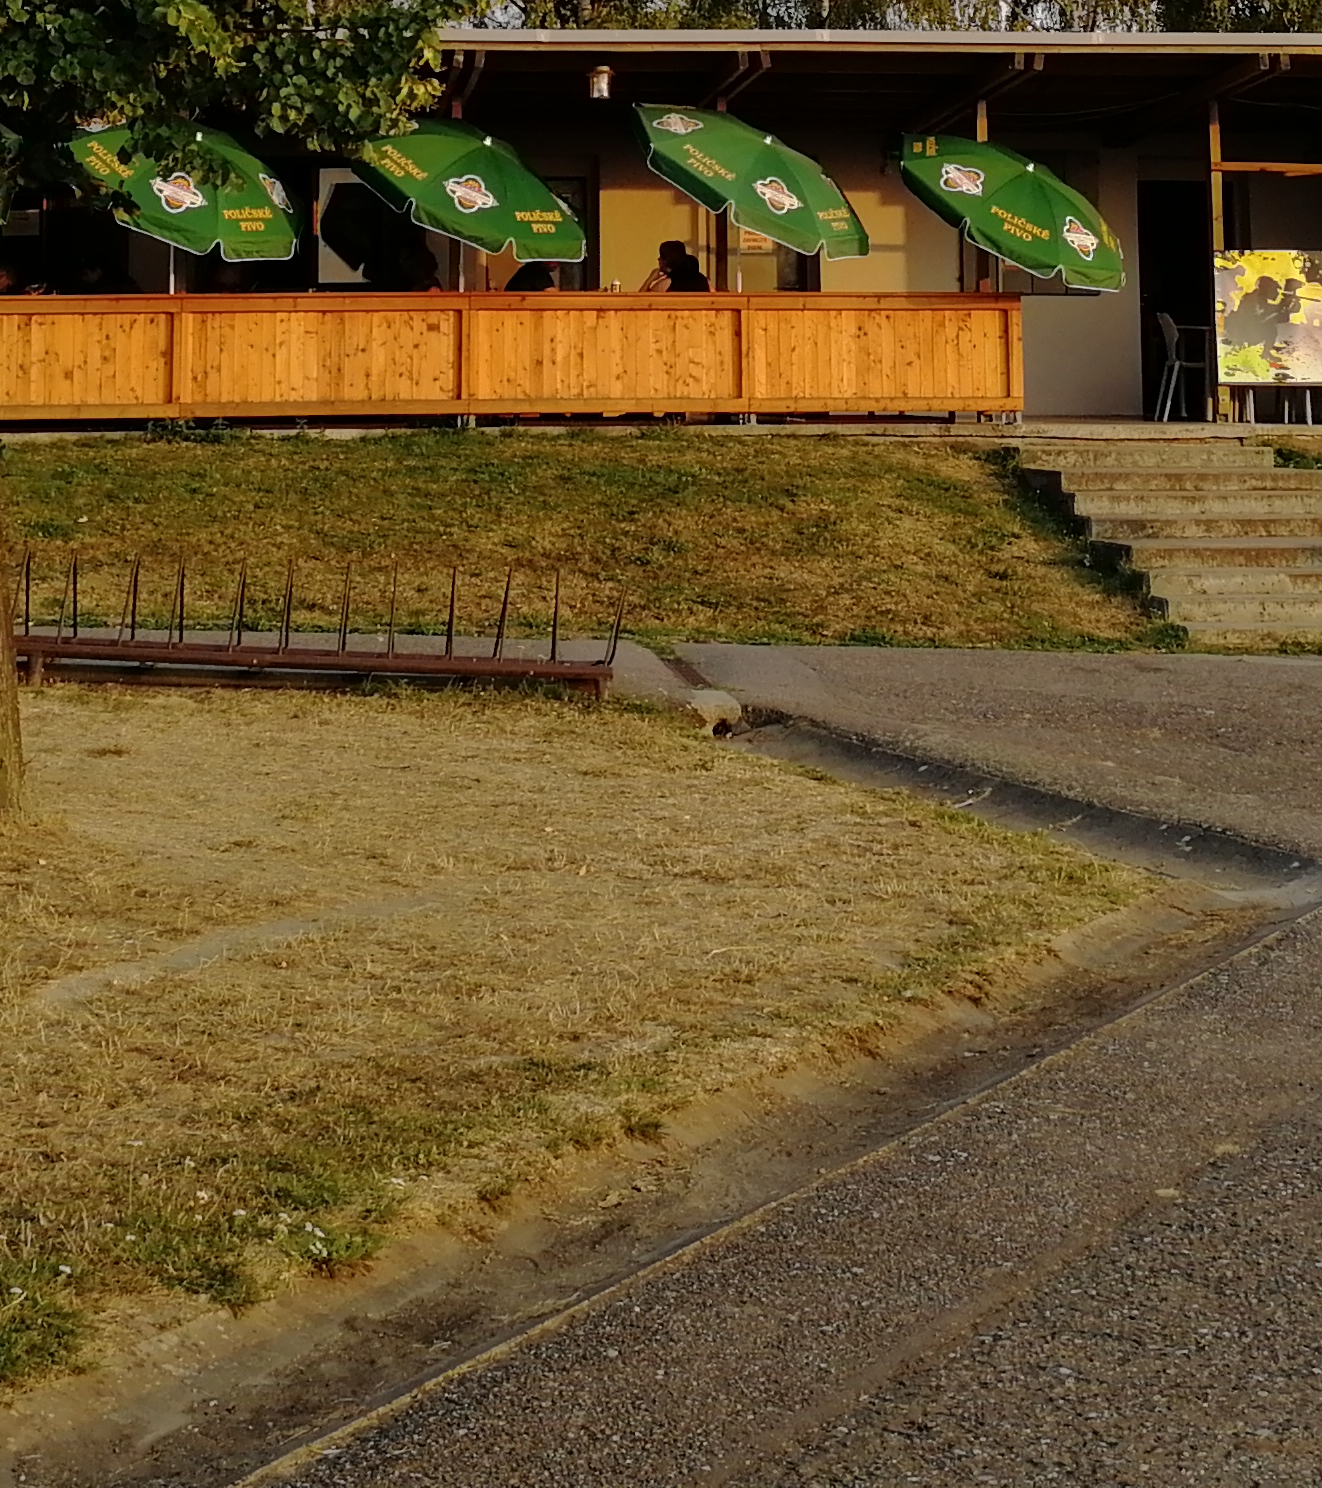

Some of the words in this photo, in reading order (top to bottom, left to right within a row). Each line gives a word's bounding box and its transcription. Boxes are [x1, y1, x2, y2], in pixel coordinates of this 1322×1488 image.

[85, 156, 110, 175] PIVO
[380, 158, 405, 178] PIVO
[381, 144, 428, 181] POLIČSKÉ
[682, 143, 737, 182] POLIČSKÉ
[686, 158, 715, 178] PIVO
[239, 221, 265, 232] PIVO
[531, 223, 556, 234] PIVO
[990, 205, 1051, 240] POLIČSKÉ
[1003, 222, 1032, 242] PIVO
